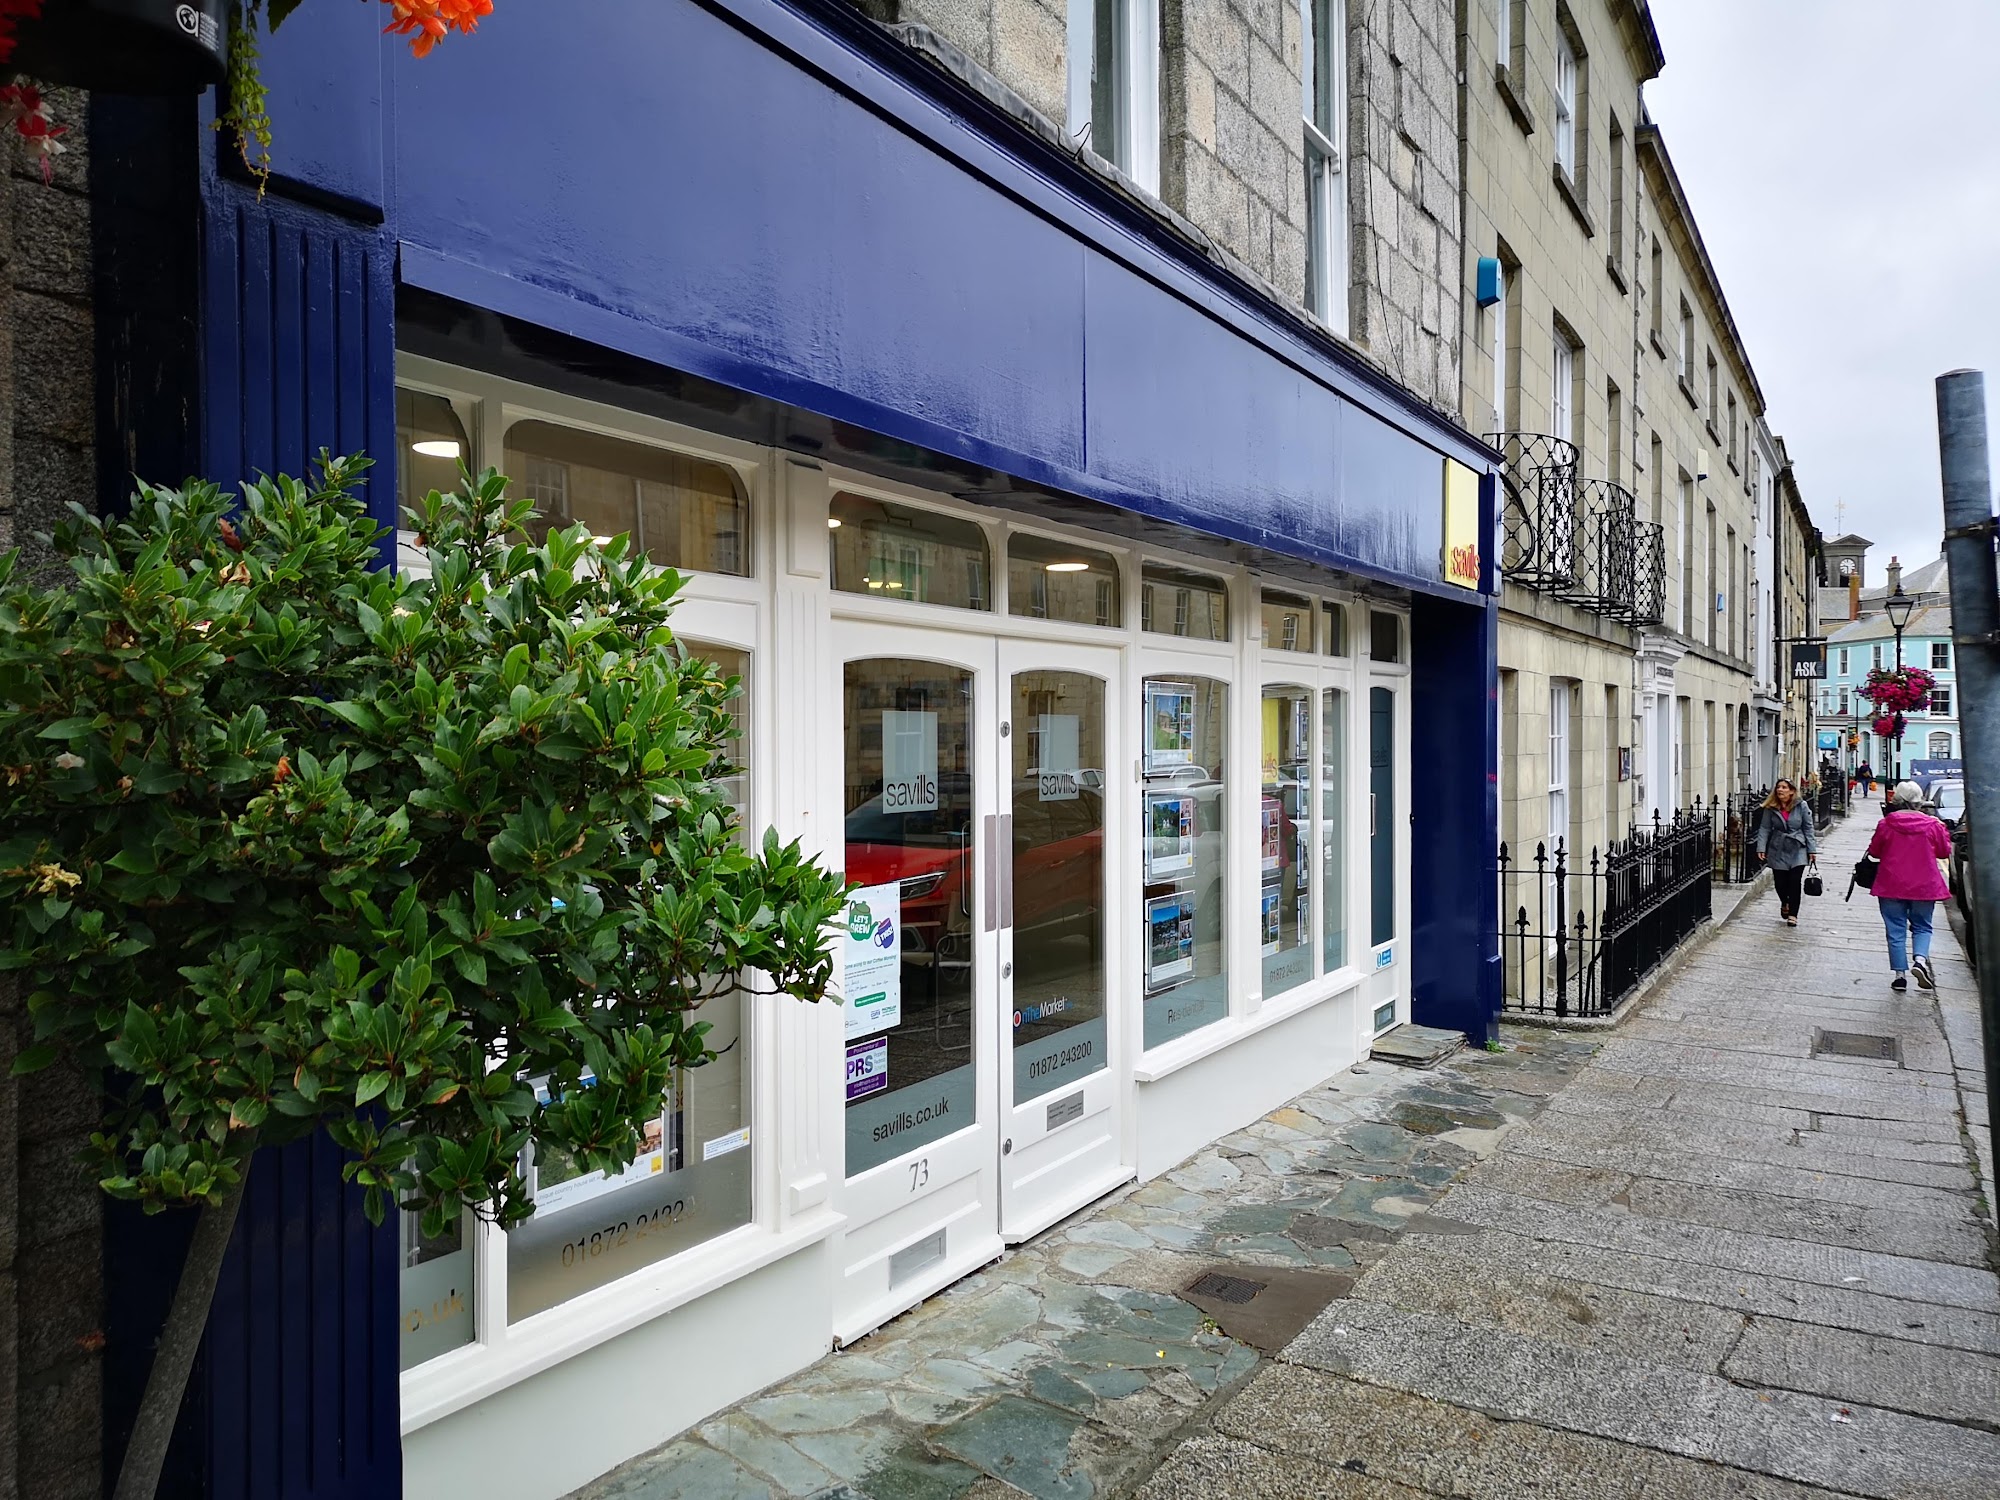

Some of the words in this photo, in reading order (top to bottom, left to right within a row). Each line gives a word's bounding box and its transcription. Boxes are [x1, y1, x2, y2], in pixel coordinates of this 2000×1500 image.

[1452, 543, 1480, 581] savills
[1795, 661, 1817, 677] ASK
[886, 775, 935, 806] savills
[1041, 769, 1077, 795] savills
[853, 914, 869, 924] LET'S
[1270, 966, 1286, 982] 01872
[847, 1054, 874, 1080] PRS
[1029, 1054, 1058, 1079] 01872
[1061, 1040, 1092, 1067] 243200
[873, 1096, 949, 1142] savills.co.uk
[554, 1184, 573, 1197] country
[573, 1179, 588, 1189] house
[908, 1158, 929, 1192] 73
[562, 1221, 629, 1268] 01872
